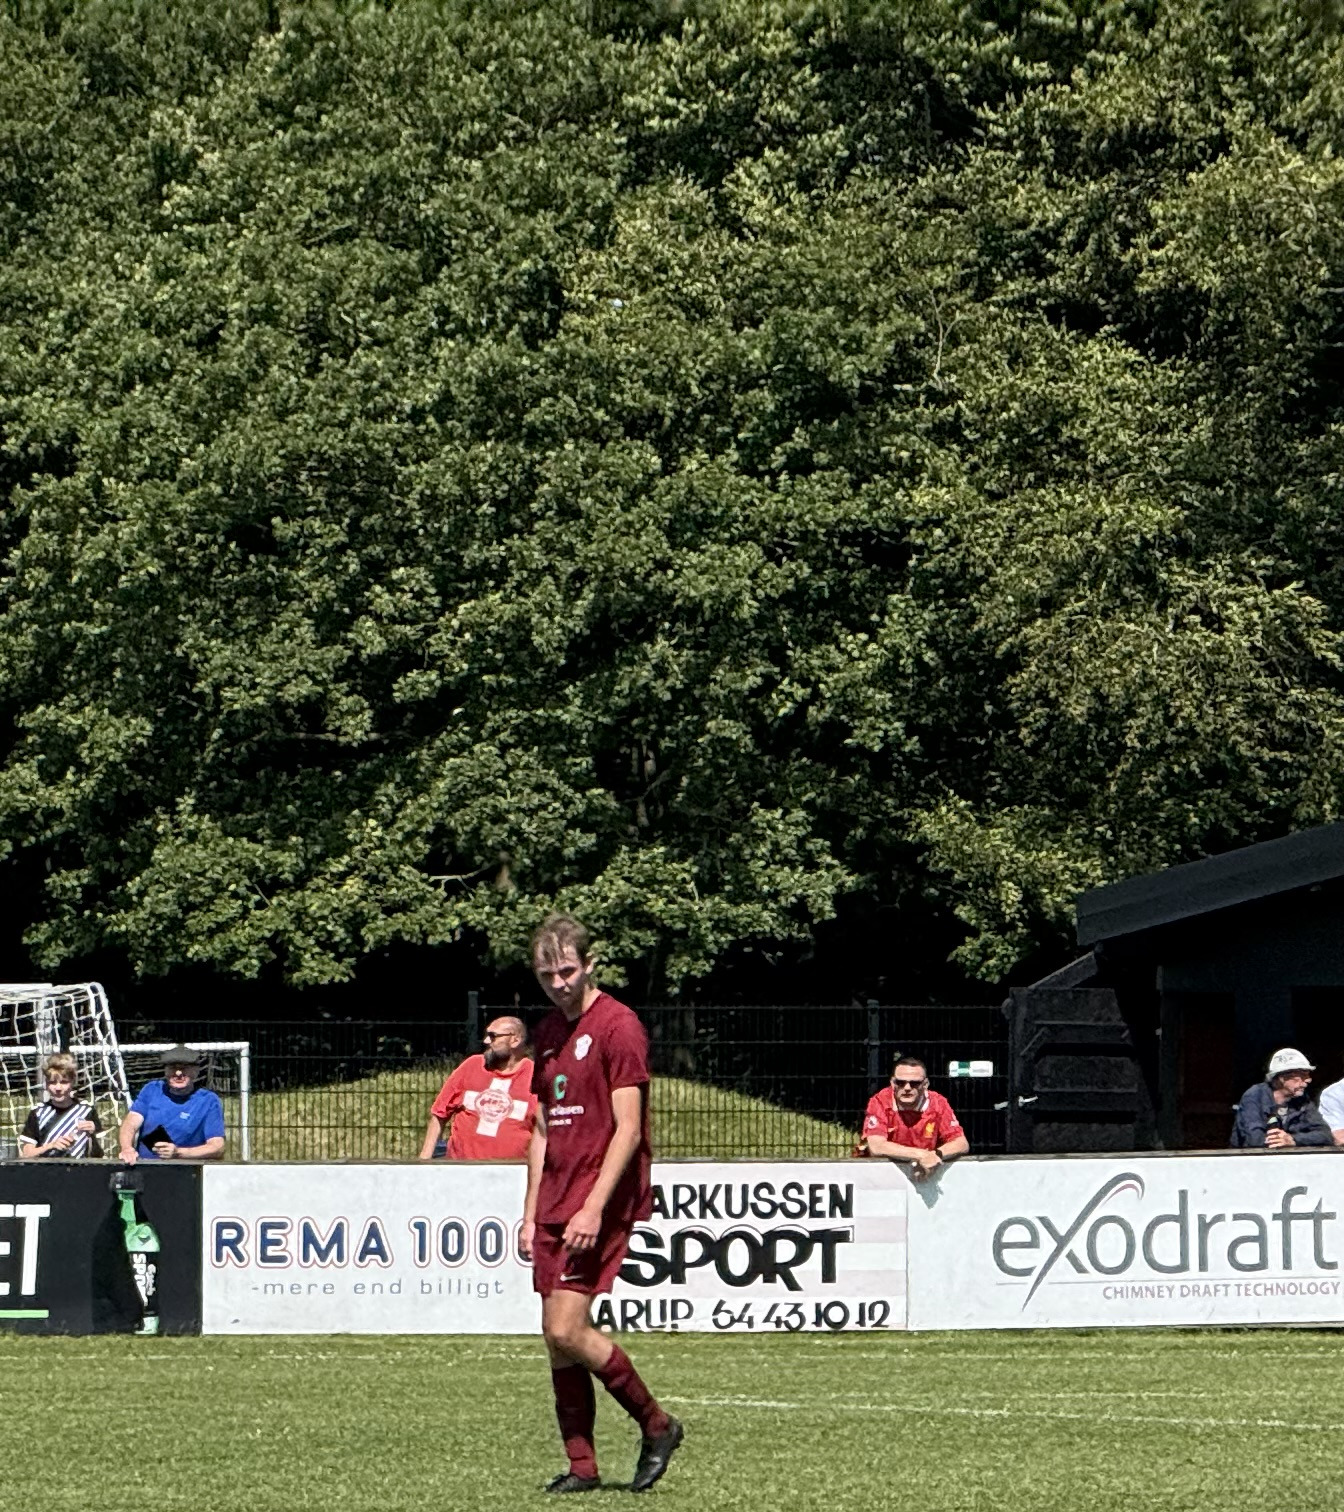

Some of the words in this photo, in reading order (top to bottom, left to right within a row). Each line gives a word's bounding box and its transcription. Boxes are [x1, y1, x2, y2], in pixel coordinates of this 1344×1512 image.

[650, 1182, 855, 1220] ARKUSSEN
[214, 1221, 390, 1264] REMA
[618, 1225, 855, 1292] SPORT
[992, 1171, 1340, 1313] exodraft
[353, 1278, 403, 1295] end
[420, 1278, 505, 1298] billigt
[1102, 1285, 1175, 1300] CHIMNEY
[1179, 1283, 1230, 1298] DRAFT
[1235, 1281, 1341, 1297] TECHNOLOGY
[592, 1298, 694, 1331] ARUP
[711, 1298, 755, 1330] 64
[761, 1302, 807, 1332] 43
[811, 1300, 851, 1330] 10
